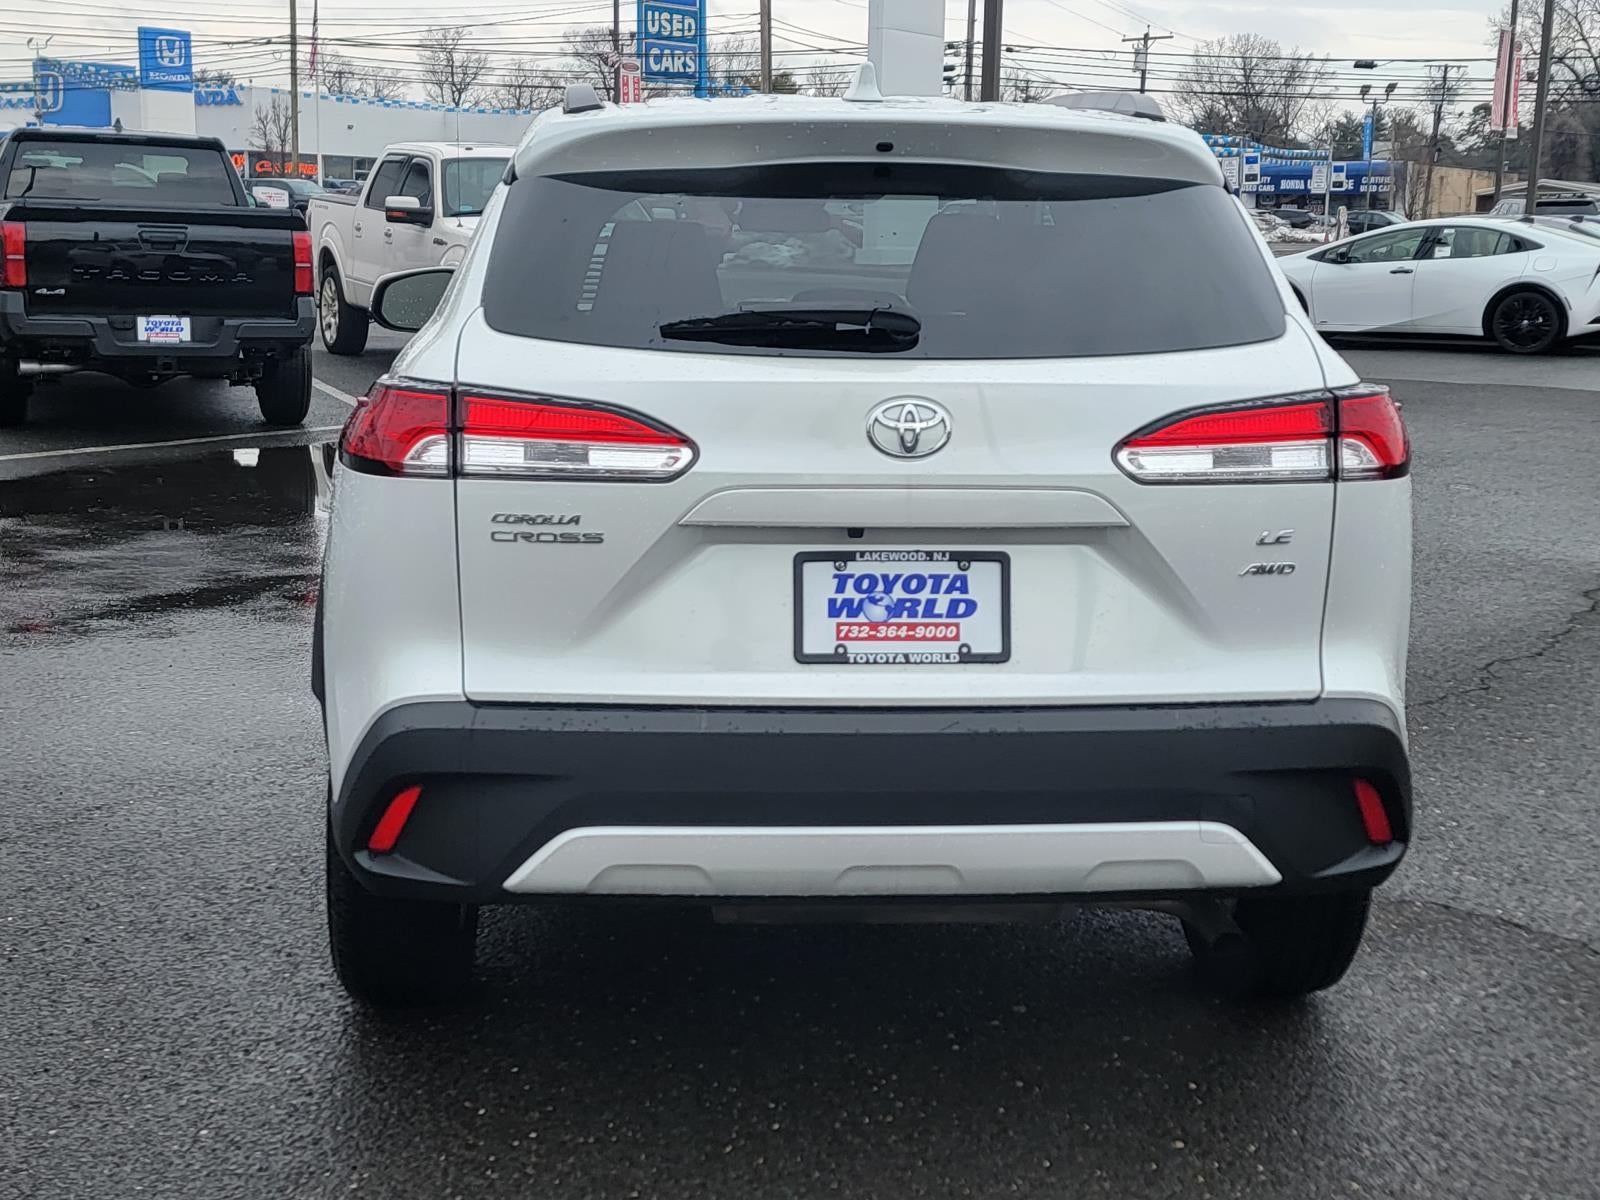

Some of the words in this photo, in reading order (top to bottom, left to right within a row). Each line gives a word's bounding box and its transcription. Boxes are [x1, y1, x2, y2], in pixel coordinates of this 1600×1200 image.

[647, 10, 696, 38] USED
[649, 47, 696, 74] CARS
[149, 71, 191, 81] HONDA
[194, 89, 243, 106] NDA
[1258, 184, 1276, 192] CARS
[1280, 179, 1305, 189] HONDA
[72, 267, 254, 283] TACOMA
[490, 512, 581, 526] COROLLA
[490, 531, 605, 544] CROSS
[1256, 529, 1294, 546] LE
[933, 551, 950, 561] NJ
[1239, 561, 1296, 577] AWD
[832, 573, 970, 595] TOYOTA
[827, 597, 978, 620] WORLD
[838, 625, 958, 639] 732-364-9000
[848, 653, 905, 664] TOYOTA
[908, 653, 961, 664] WORLD
